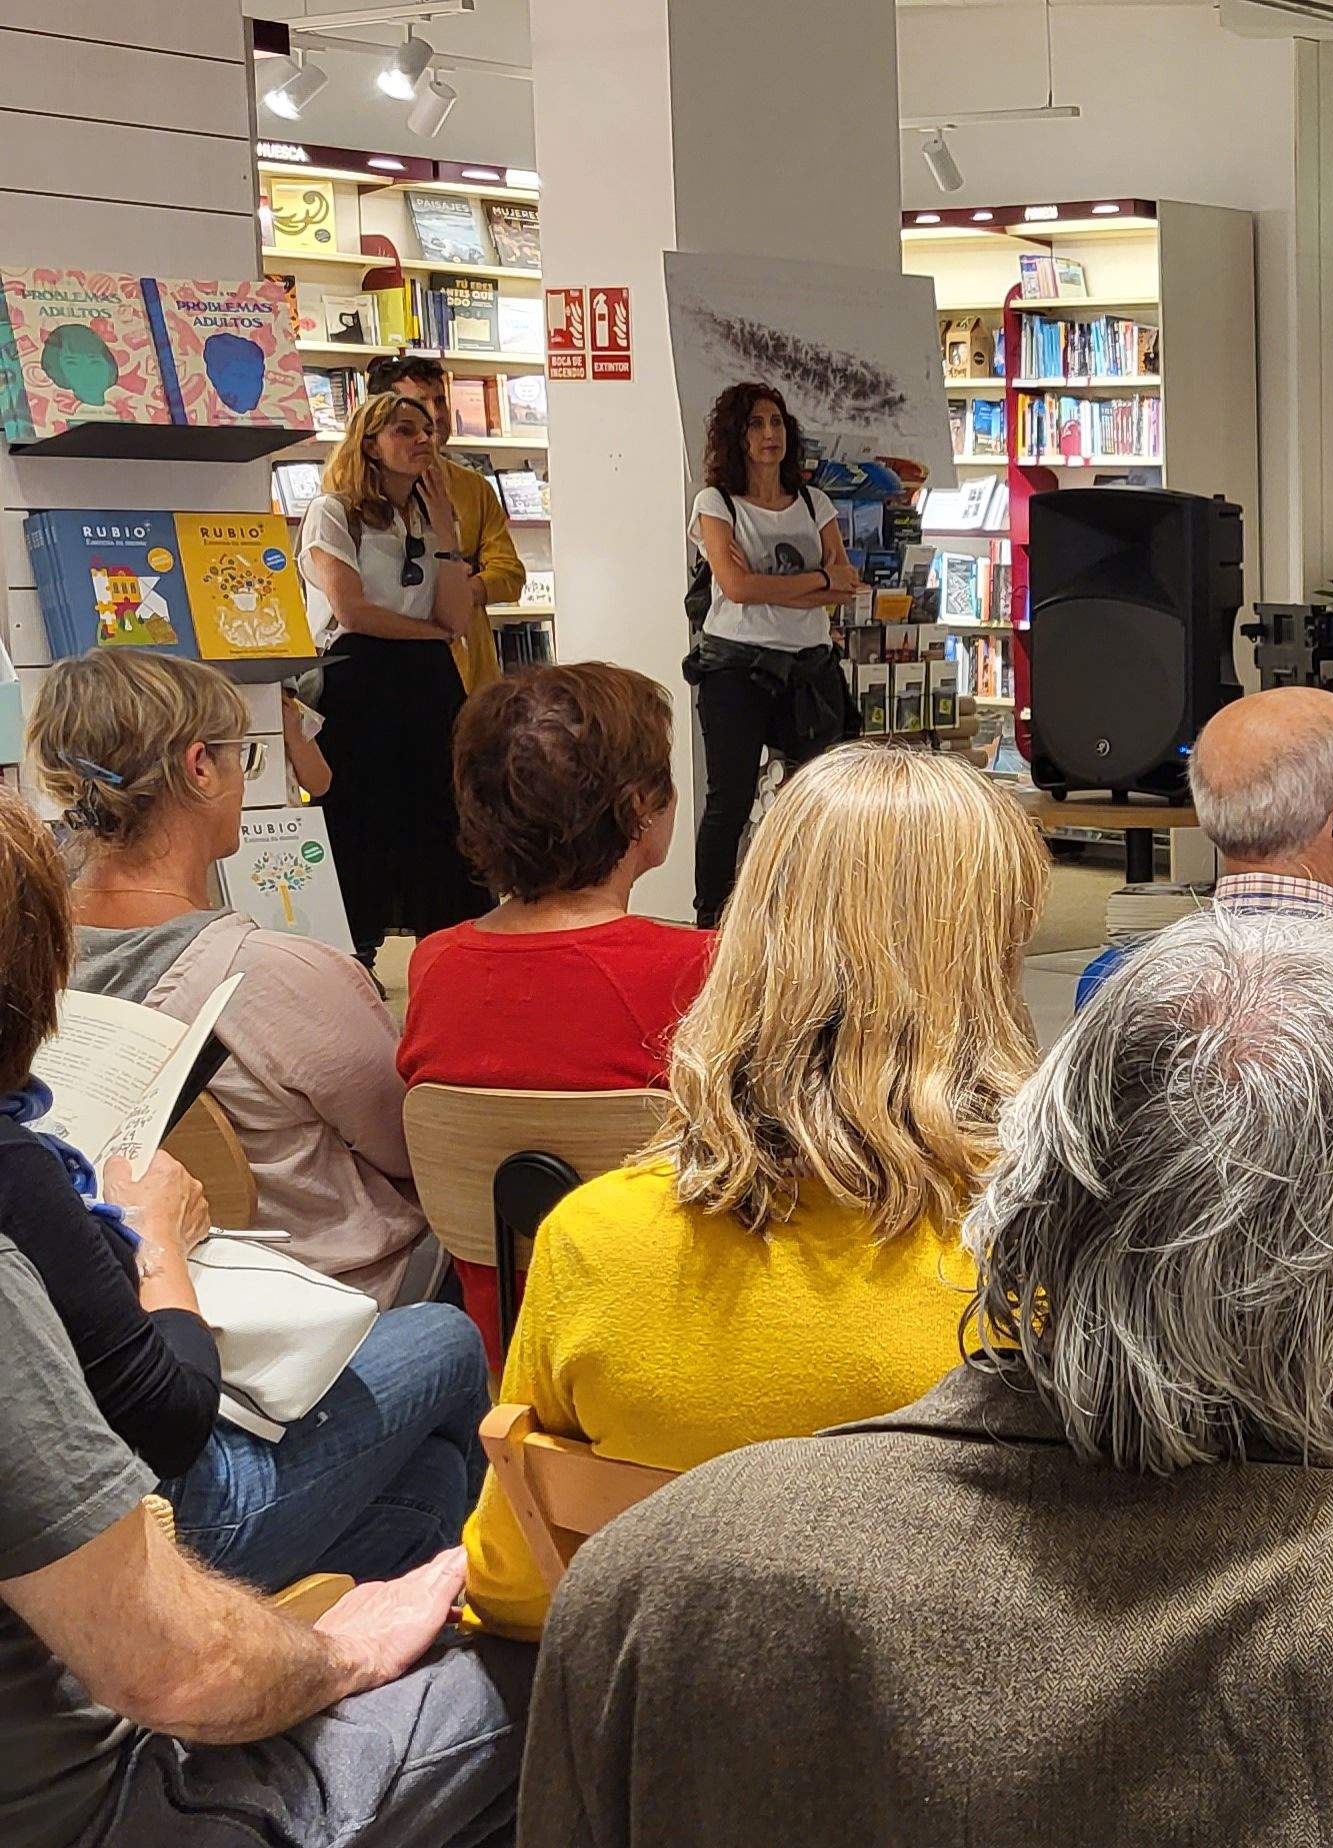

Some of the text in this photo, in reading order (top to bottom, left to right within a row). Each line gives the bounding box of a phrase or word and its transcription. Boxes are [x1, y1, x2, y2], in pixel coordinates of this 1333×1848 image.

[416, 198, 470, 213] PAISAJES
[40, 305, 112, 319] ADULTOS
[176, 300, 273, 314] PROBLEMAS
[193, 316, 264, 329] ADULTOS
[551, 356, 583, 367] BOCA DE
[594, 362, 629, 373] EXTINTOR
[550, 367, 585, 378] INCENDIO
[82, 525, 147, 538] RUBIO
[200, 527, 260, 539] RUBIO
[240, 822, 298, 836] RUBIO
